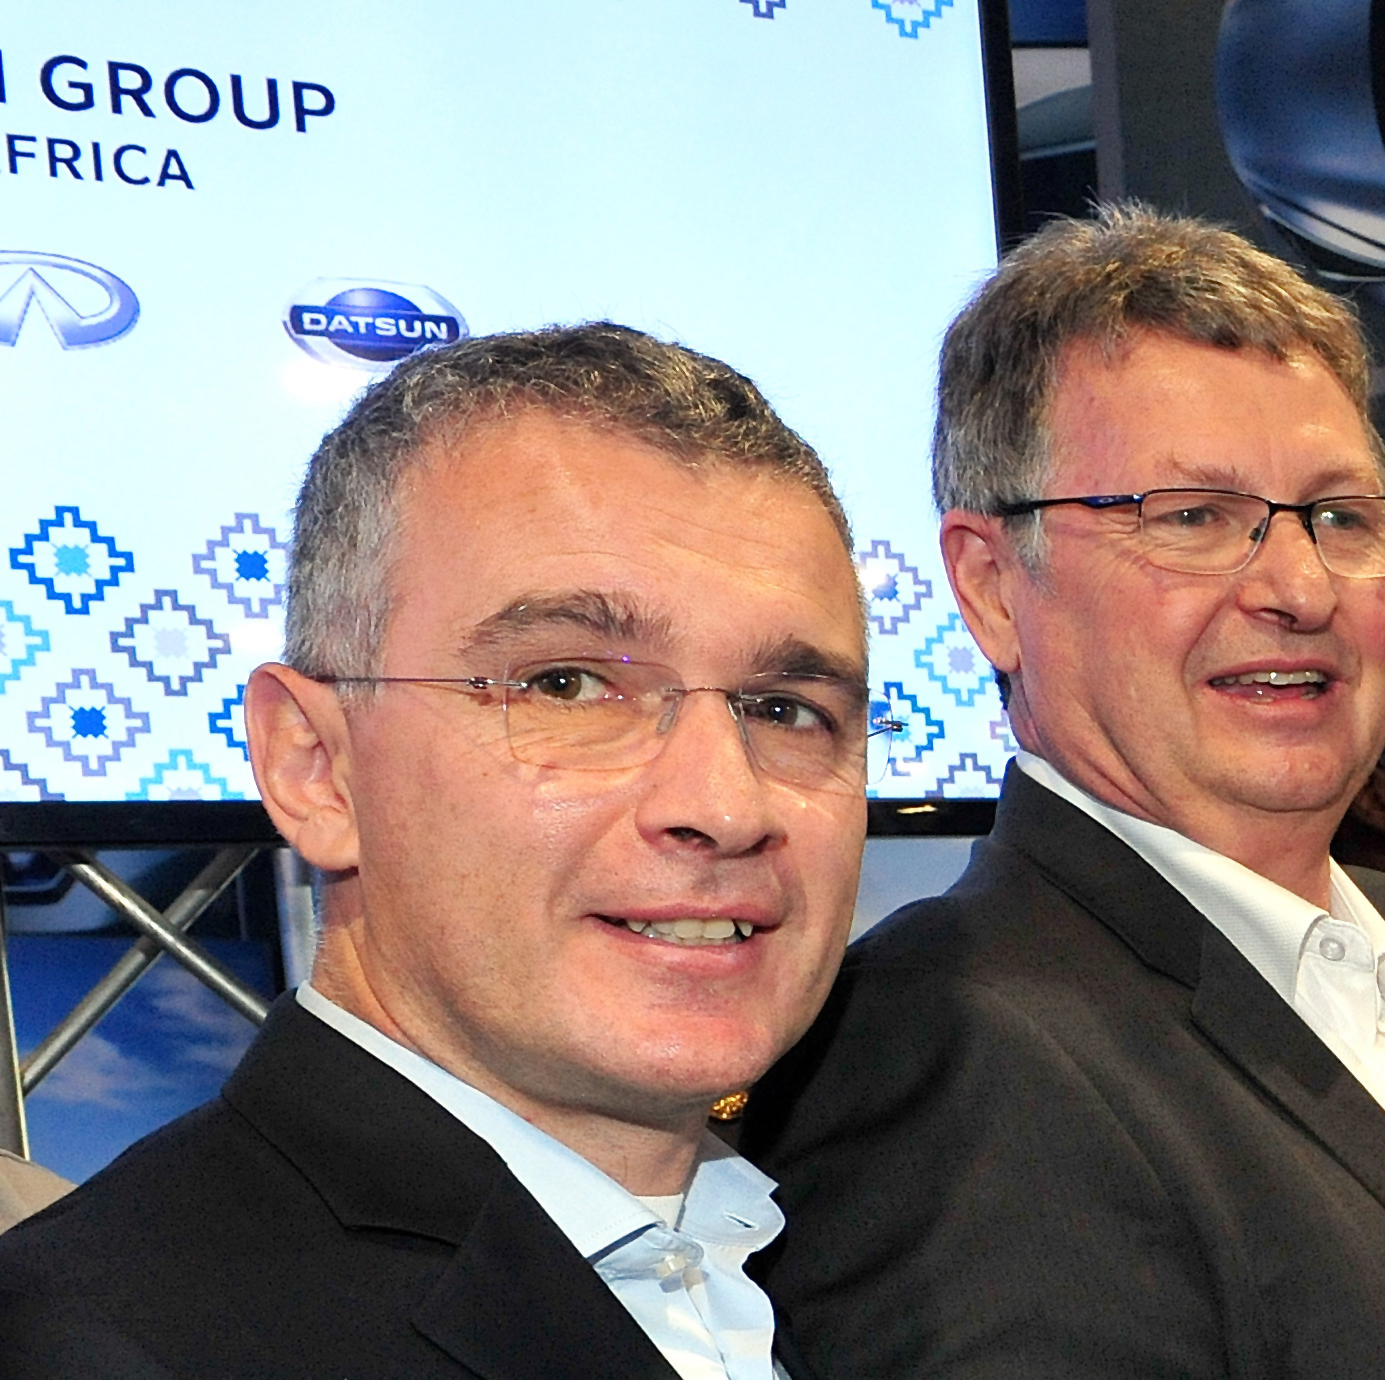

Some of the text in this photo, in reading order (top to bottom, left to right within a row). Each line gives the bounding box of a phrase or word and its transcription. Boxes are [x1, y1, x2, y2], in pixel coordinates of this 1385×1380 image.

[38, 54, 337, 133] GROUP
[0, 133, 196, 190] FRICA
[301, 311, 449, 340] DATSUN
